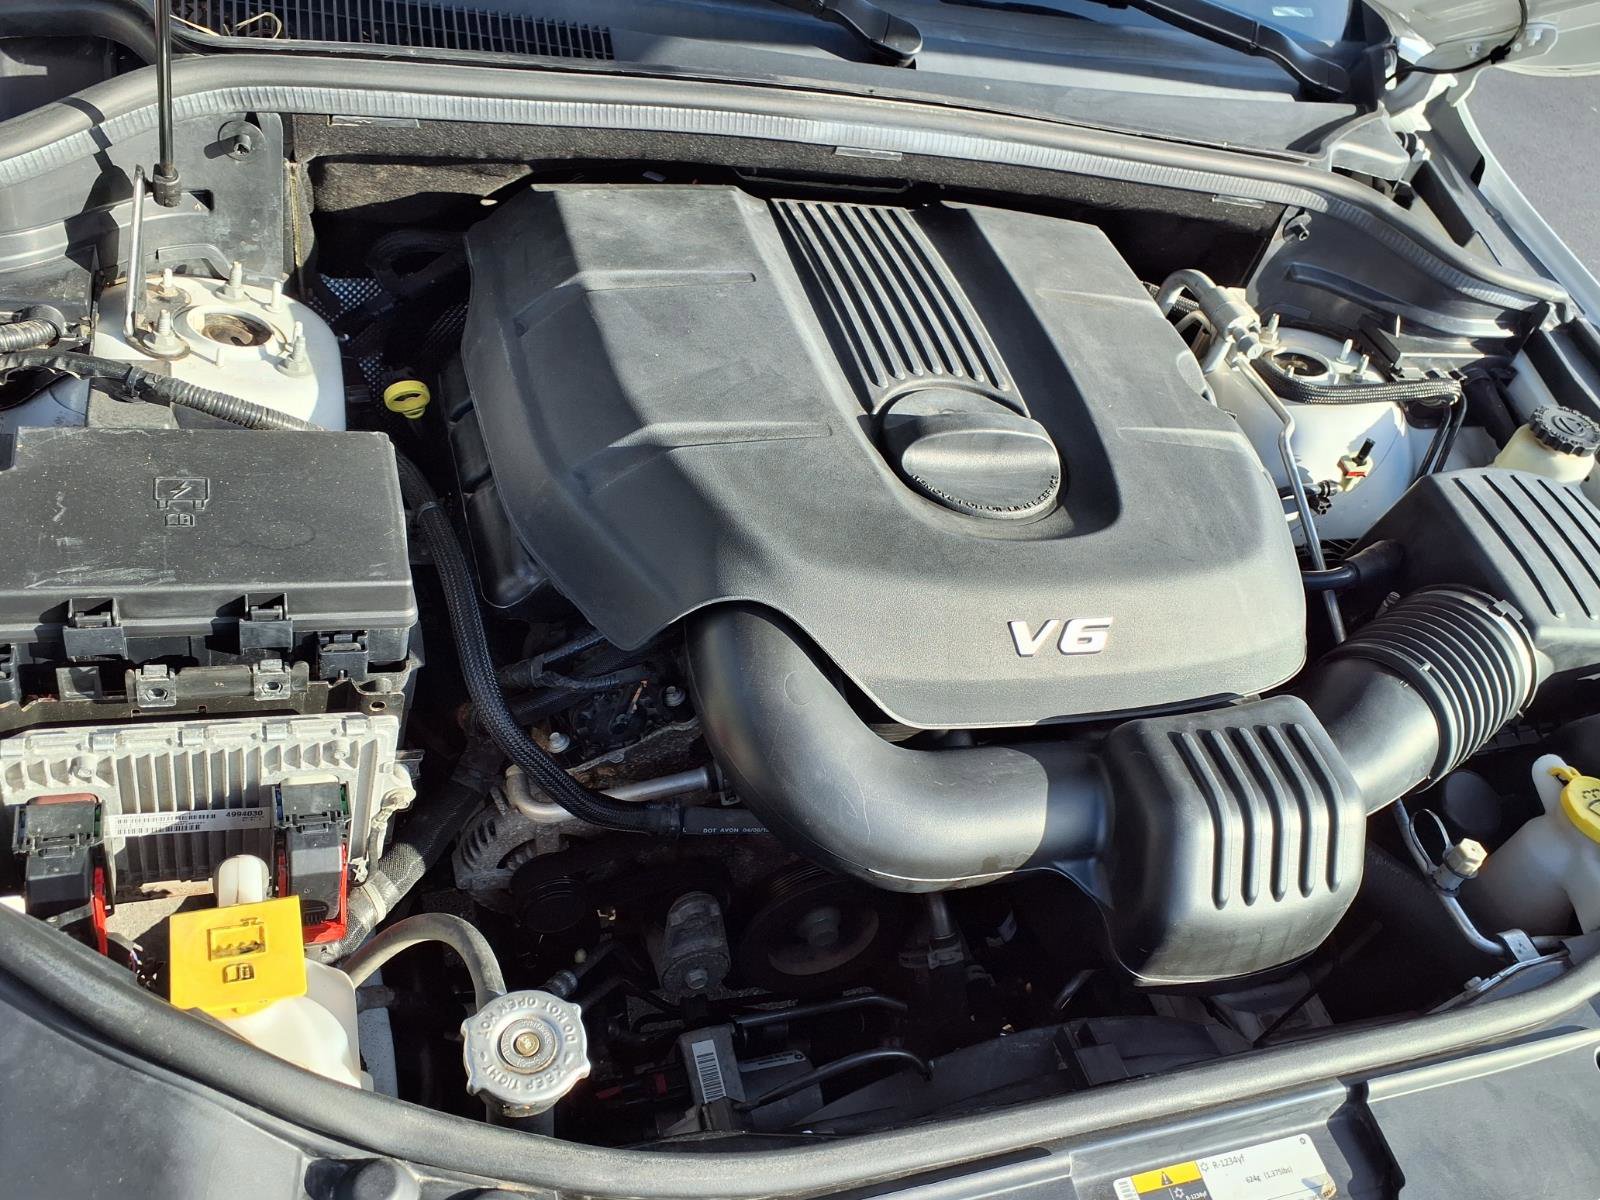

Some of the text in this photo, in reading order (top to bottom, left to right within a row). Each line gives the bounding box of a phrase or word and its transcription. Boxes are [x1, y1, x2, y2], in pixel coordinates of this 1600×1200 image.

[1007, 617, 1114, 657] V6
[500, 996, 538, 1014] OPEN
[544, 1001, 568, 1024] NOT
[479, 1013, 500, 1038] HOT
[563, 1024, 577, 1044] DO
[482, 1064, 567, 1091] KEEP TIGHT
[1212, 1153, 1246, 1169] R-1234yf
